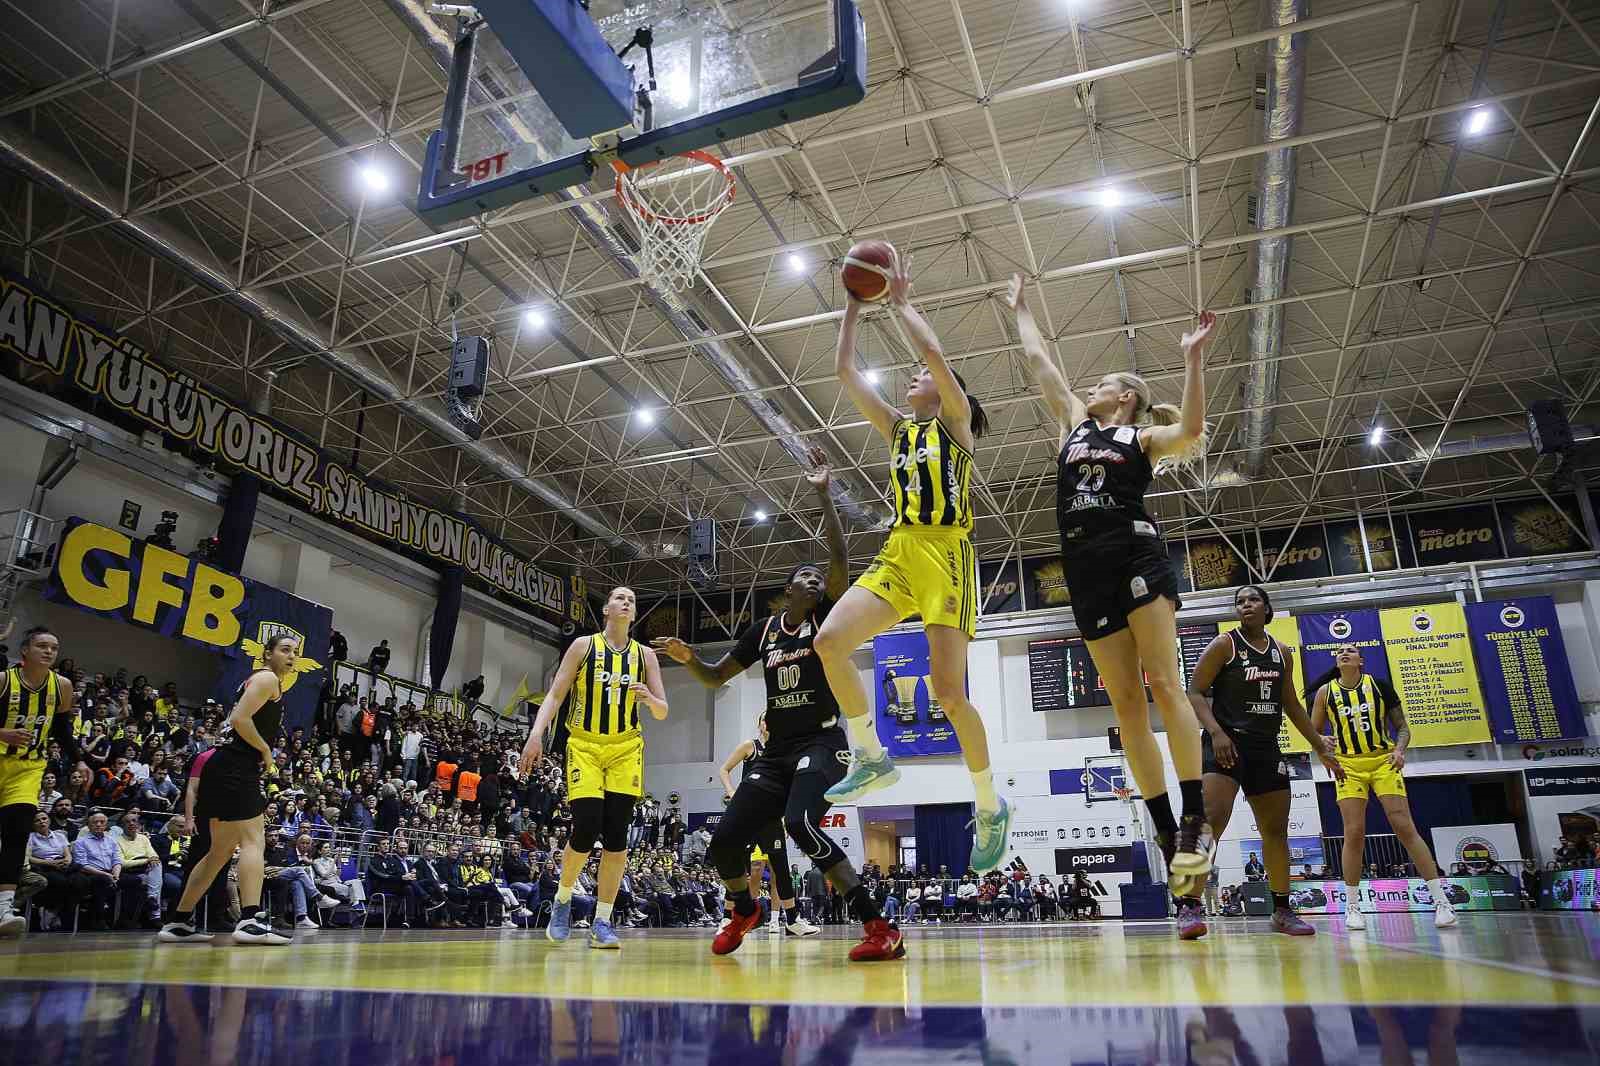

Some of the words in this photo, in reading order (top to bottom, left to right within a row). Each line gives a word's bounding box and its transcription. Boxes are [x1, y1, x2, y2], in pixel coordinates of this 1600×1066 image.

[80, 327, 320, 511] YÜRÜYORUZ,
[905, 471, 922, 495] 4
[1076, 464, 1105, 492] 23
[1420, 528, 1492, 551] metro
[58, 523, 246, 647] GFB
[1387, 635, 1434, 646] EUROLEAGUE
[1436, 632, 1466, 641] WOMEN
[777, 664, 800, 690] 00
[605, 686, 621, 705] 11
[1260, 681, 1273, 700] 15
[1349, 716, 1371, 732] 15
[1012, 829, 1048, 838] PETRONET
[1072, 854, 1115, 867] papara
[1332, 889, 1363, 904] Fod
[1369, 888, 1409, 903] Puma
